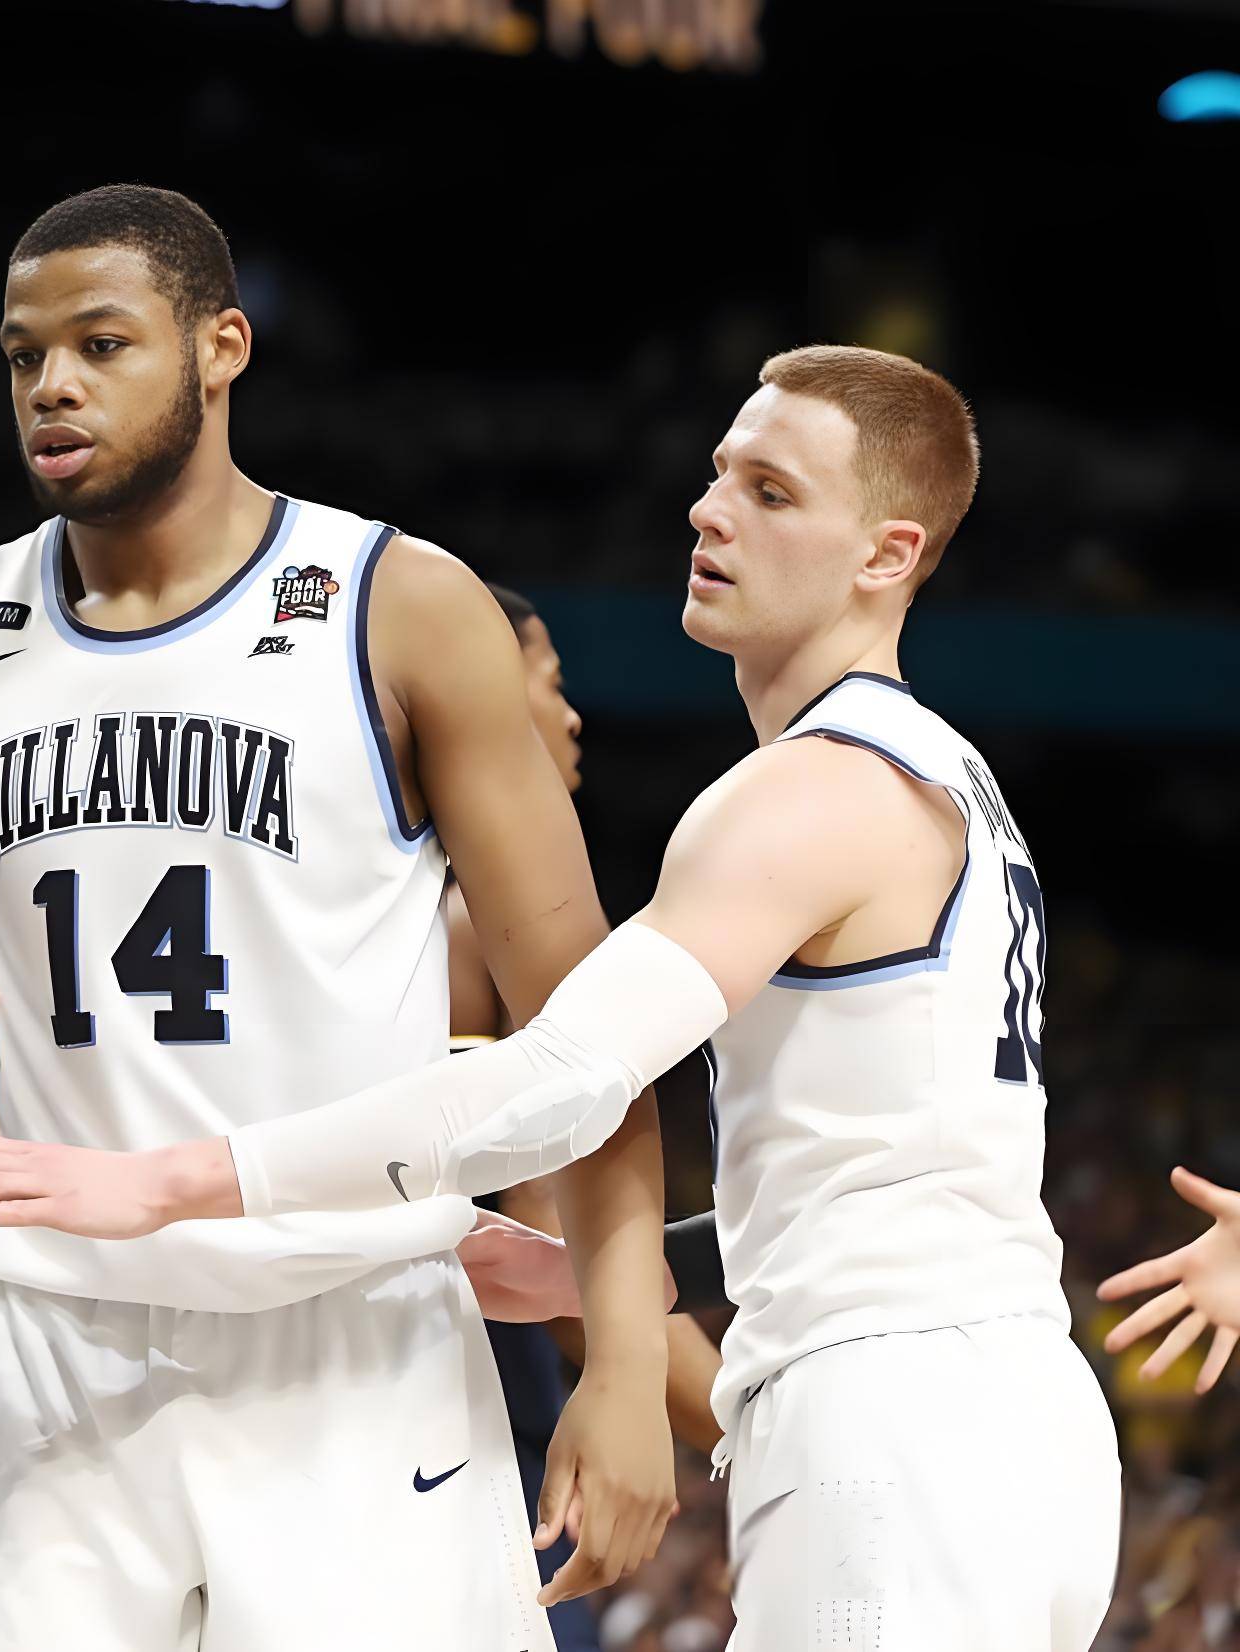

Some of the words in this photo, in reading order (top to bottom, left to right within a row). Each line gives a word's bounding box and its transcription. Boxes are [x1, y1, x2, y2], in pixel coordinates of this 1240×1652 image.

[275, 577, 326, 595] FINAL
[280, 588, 326, 606] FOUR
[33, 865, 230, 1048] 14
